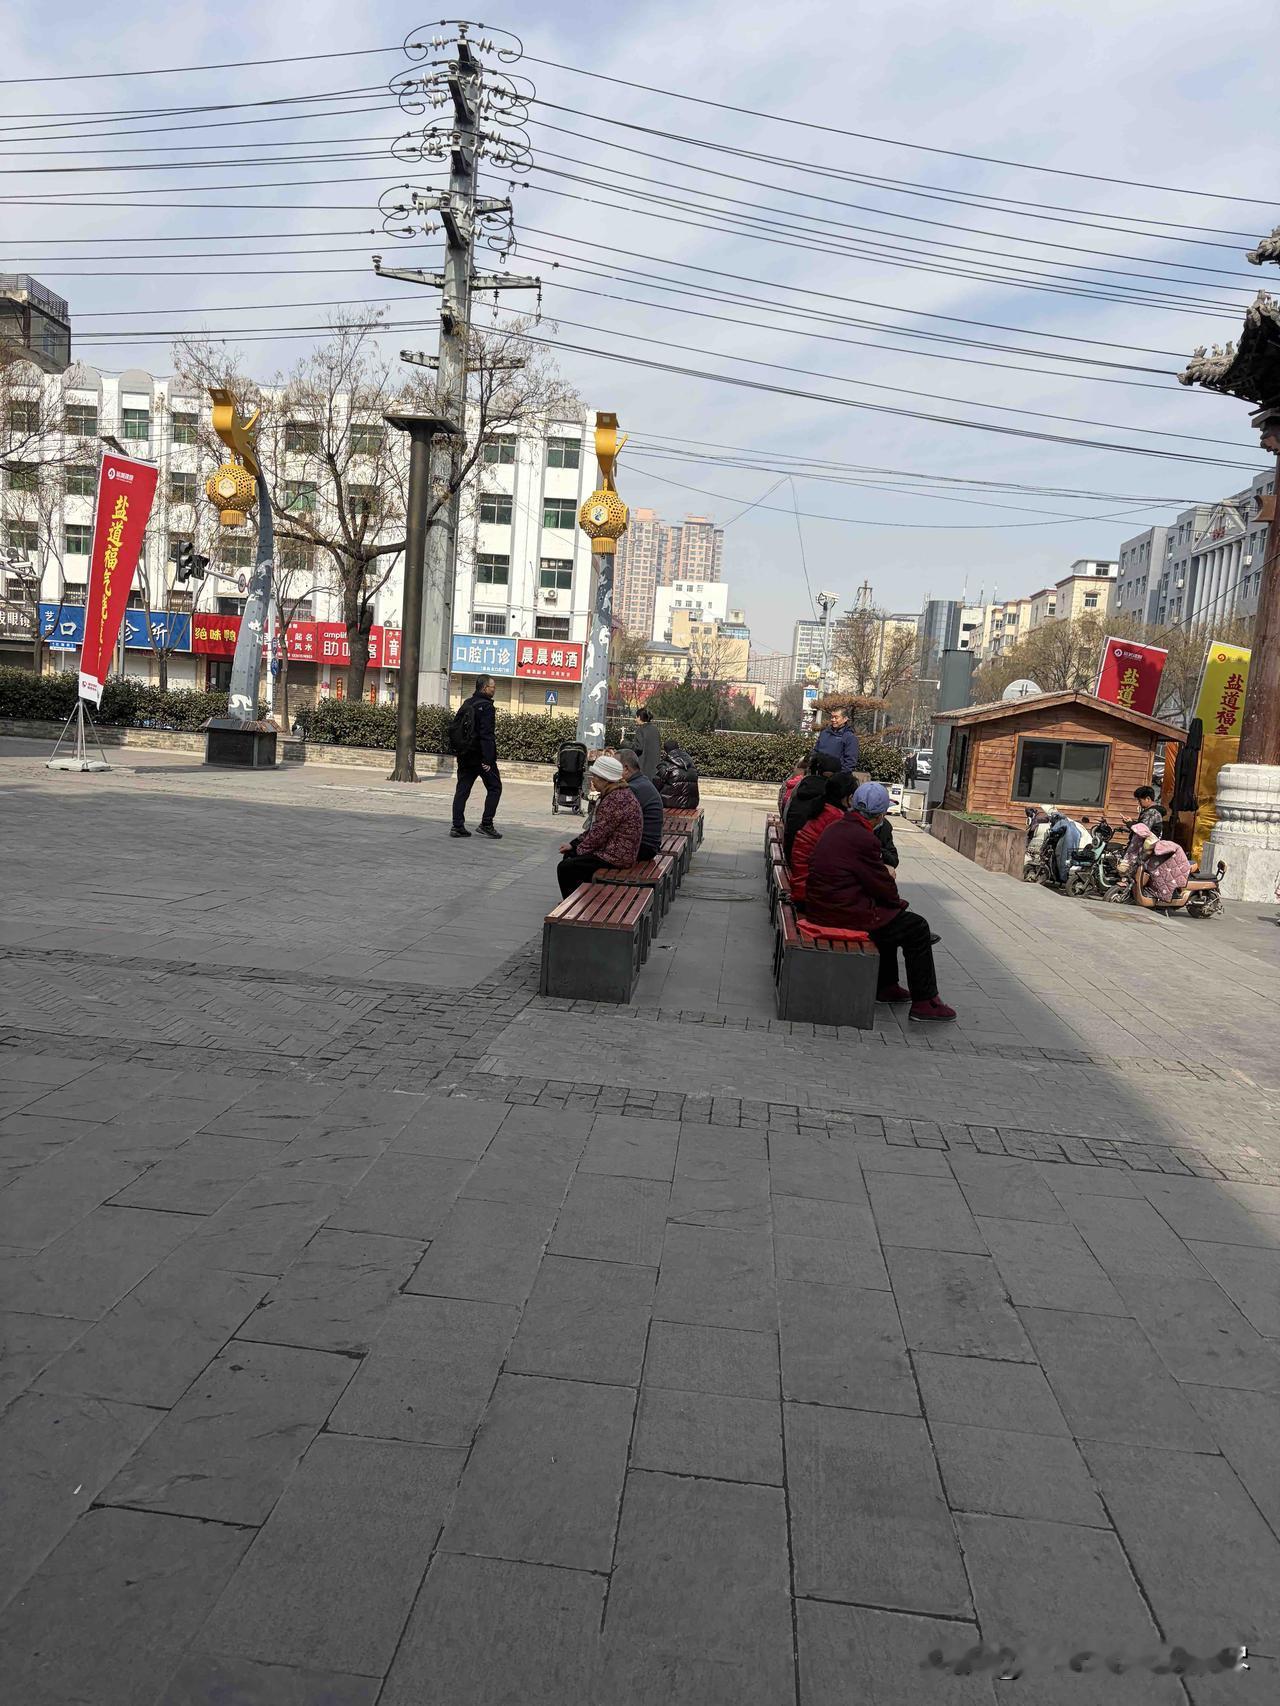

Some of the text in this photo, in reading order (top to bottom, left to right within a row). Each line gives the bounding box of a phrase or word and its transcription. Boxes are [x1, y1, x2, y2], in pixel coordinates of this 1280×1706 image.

[456, 646, 511, 665] 口腔门诊
[521, 647, 578, 668] 晨晨烟酒
